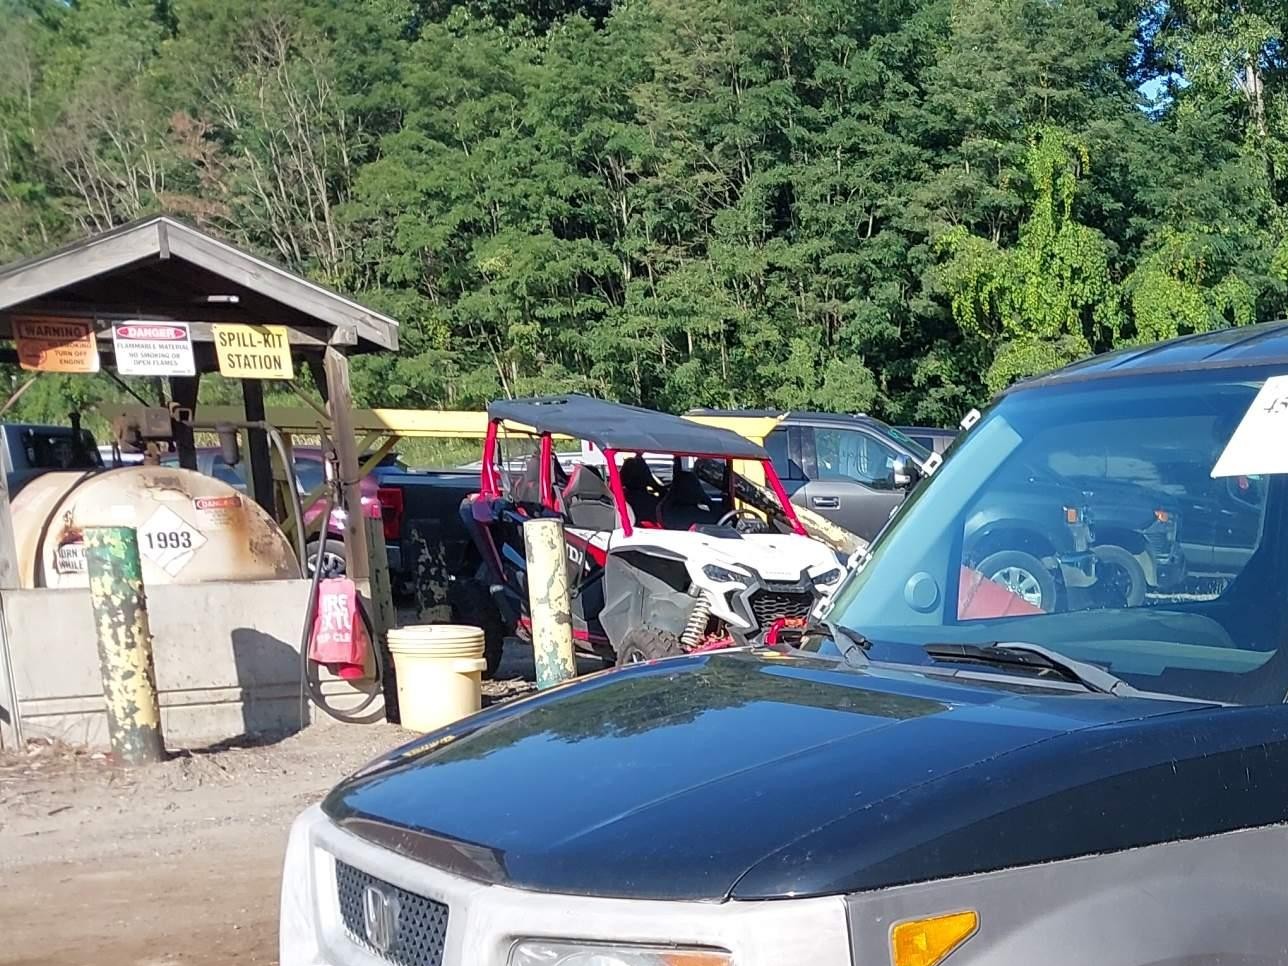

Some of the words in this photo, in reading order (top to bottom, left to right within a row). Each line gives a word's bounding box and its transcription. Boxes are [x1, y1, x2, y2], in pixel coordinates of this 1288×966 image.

[25, 325, 82, 338] WARNING
[128, 326, 174, 338] DANGER
[218, 331, 283, 349] SPILL-KIT
[116, 342, 157, 350] FLAMMABLE
[158, 343, 189, 351] MATERIAL
[140, 352, 170, 360] SMOKING
[226, 352, 283, 370] STATION
[133, 359, 151, 367] OPEN
[144, 531, 192, 549] 1993
